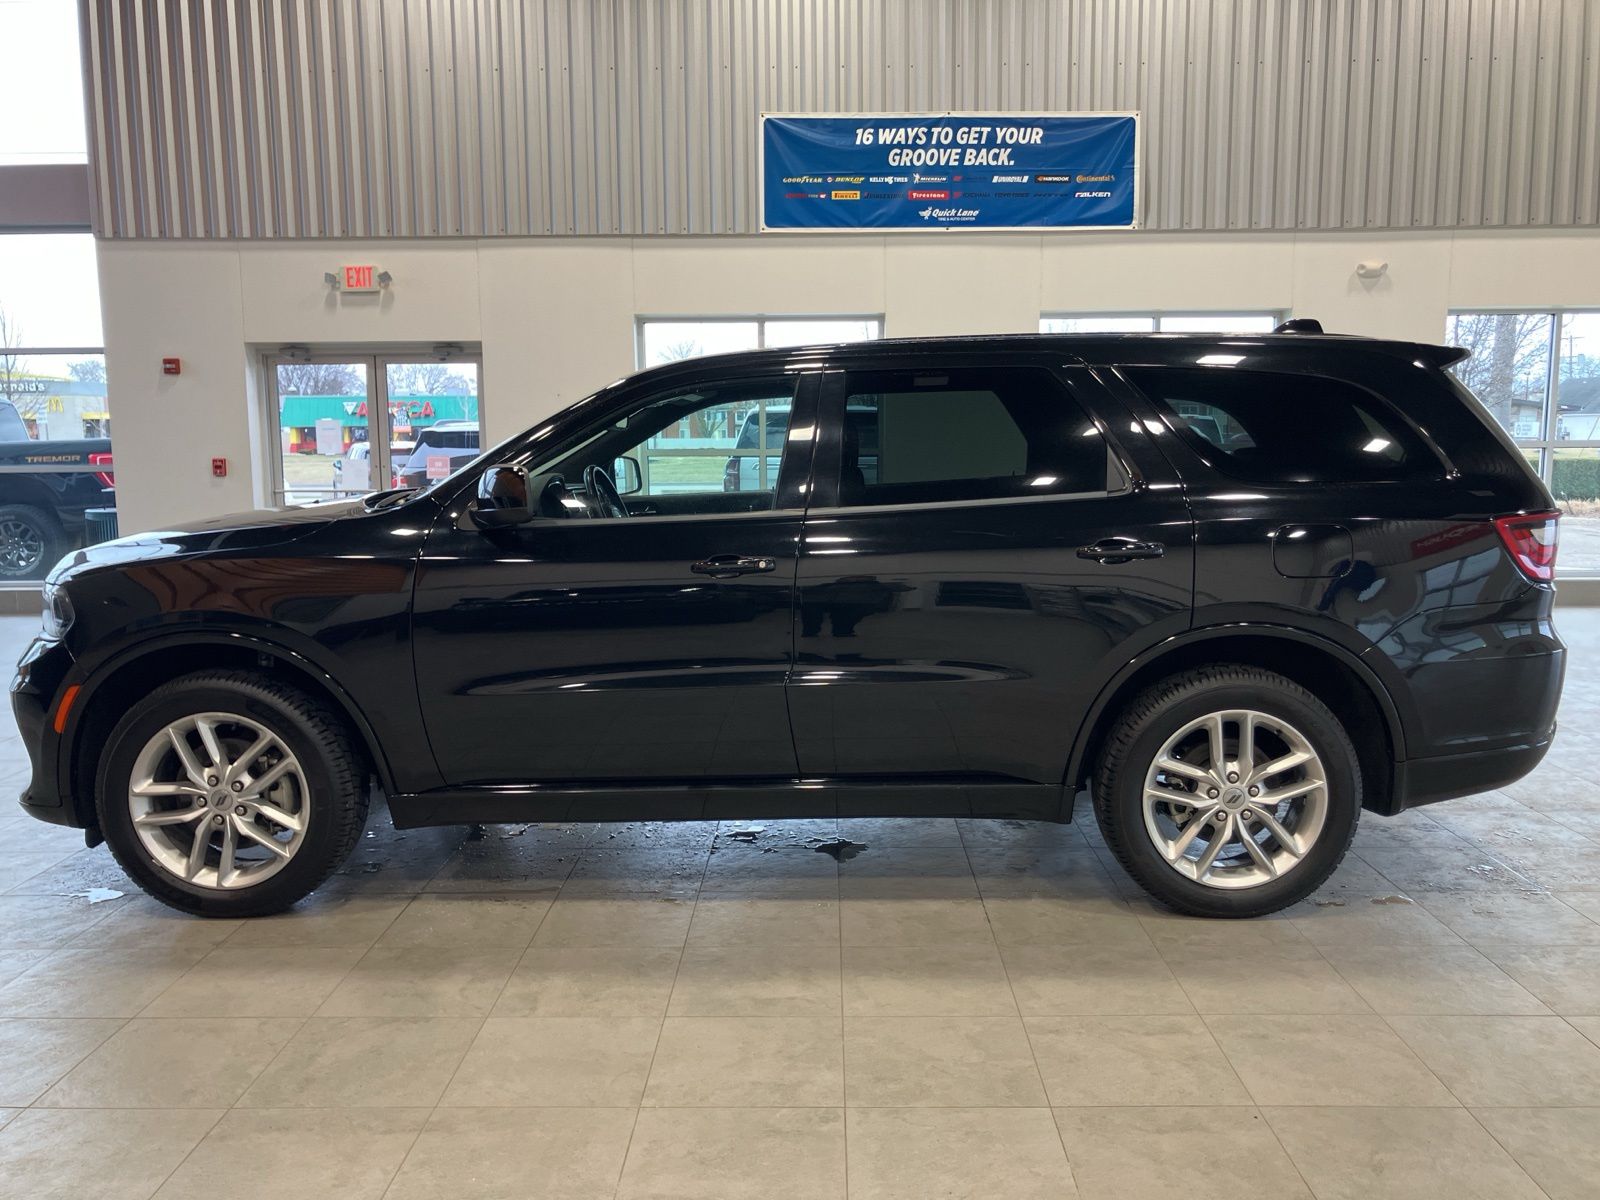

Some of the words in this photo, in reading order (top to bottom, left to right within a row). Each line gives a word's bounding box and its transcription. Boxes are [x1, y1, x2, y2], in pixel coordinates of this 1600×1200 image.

[855, 128, 874, 145] 16
[878, 127, 928, 145] WAYS
[931, 127, 953, 145] TO
[956, 127, 991, 145] GET
[995, 127, 1044, 144] YOUR
[888, 148, 961, 166] GROOVE
[964, 148, 1015, 166] BACK.
[1076, 175, 1110, 183] Continental
[932, 208, 957, 217] Quick
[957, 208, 979, 217] Lane
[346, 266, 372, 288] EXIT
[25, 455, 80, 463] TREMOR
